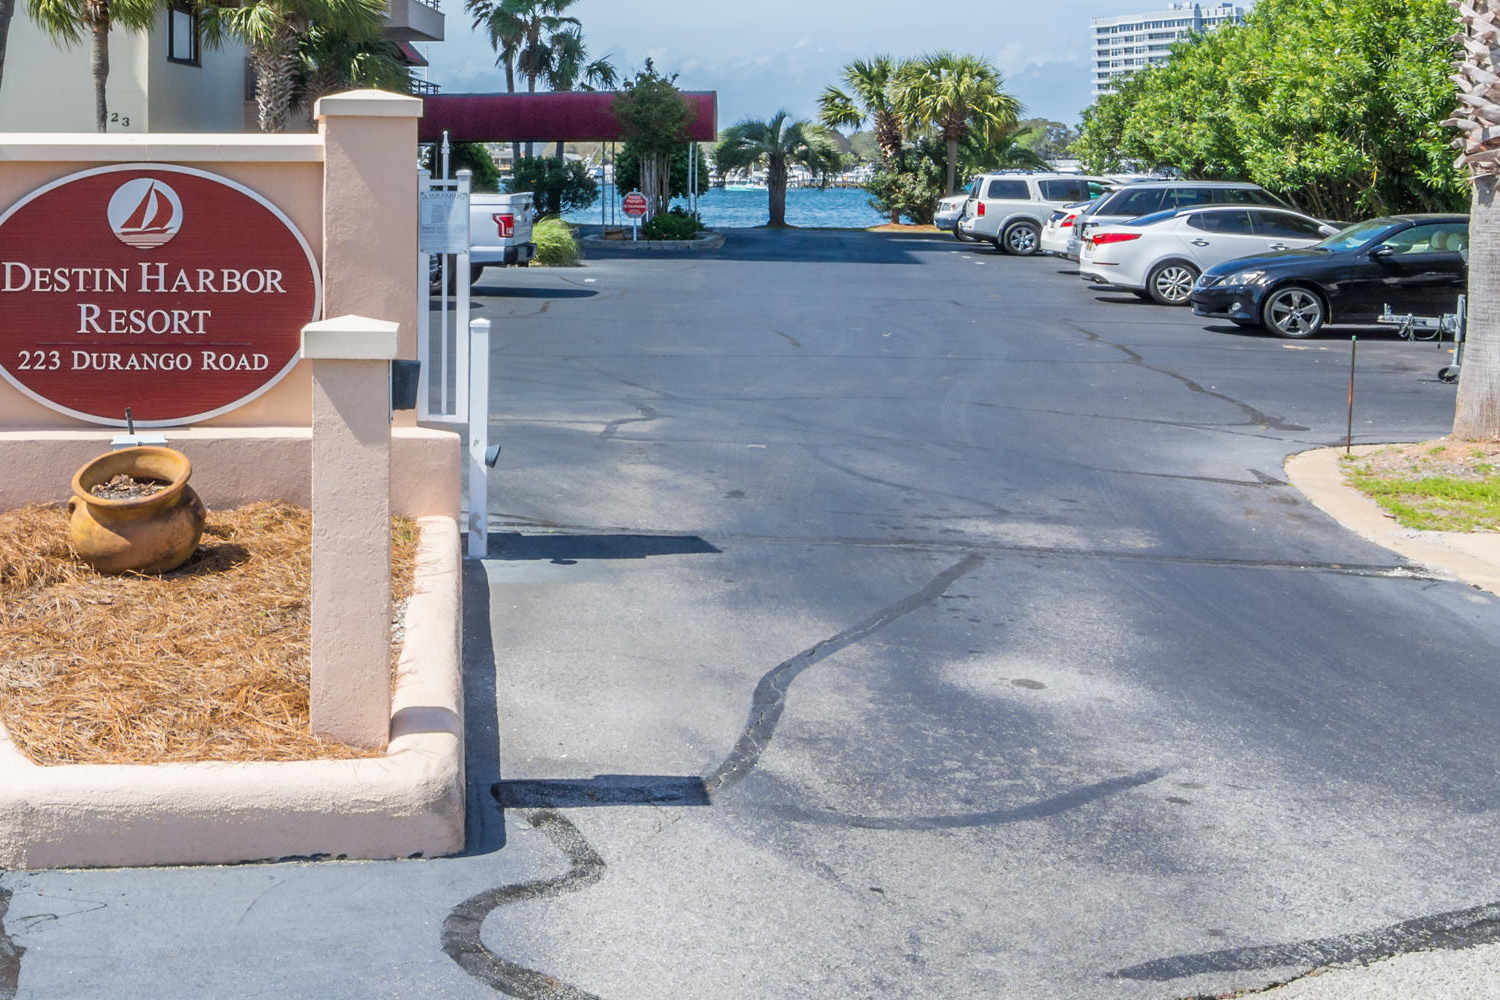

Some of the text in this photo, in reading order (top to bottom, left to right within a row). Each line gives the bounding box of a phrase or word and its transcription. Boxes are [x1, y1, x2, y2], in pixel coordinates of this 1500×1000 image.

[1, 261, 287, 294] DESTIN HARBOR
[76, 303, 212, 335] RESORT
[17, 350, 269, 371] 223 DURANGO ROAD
